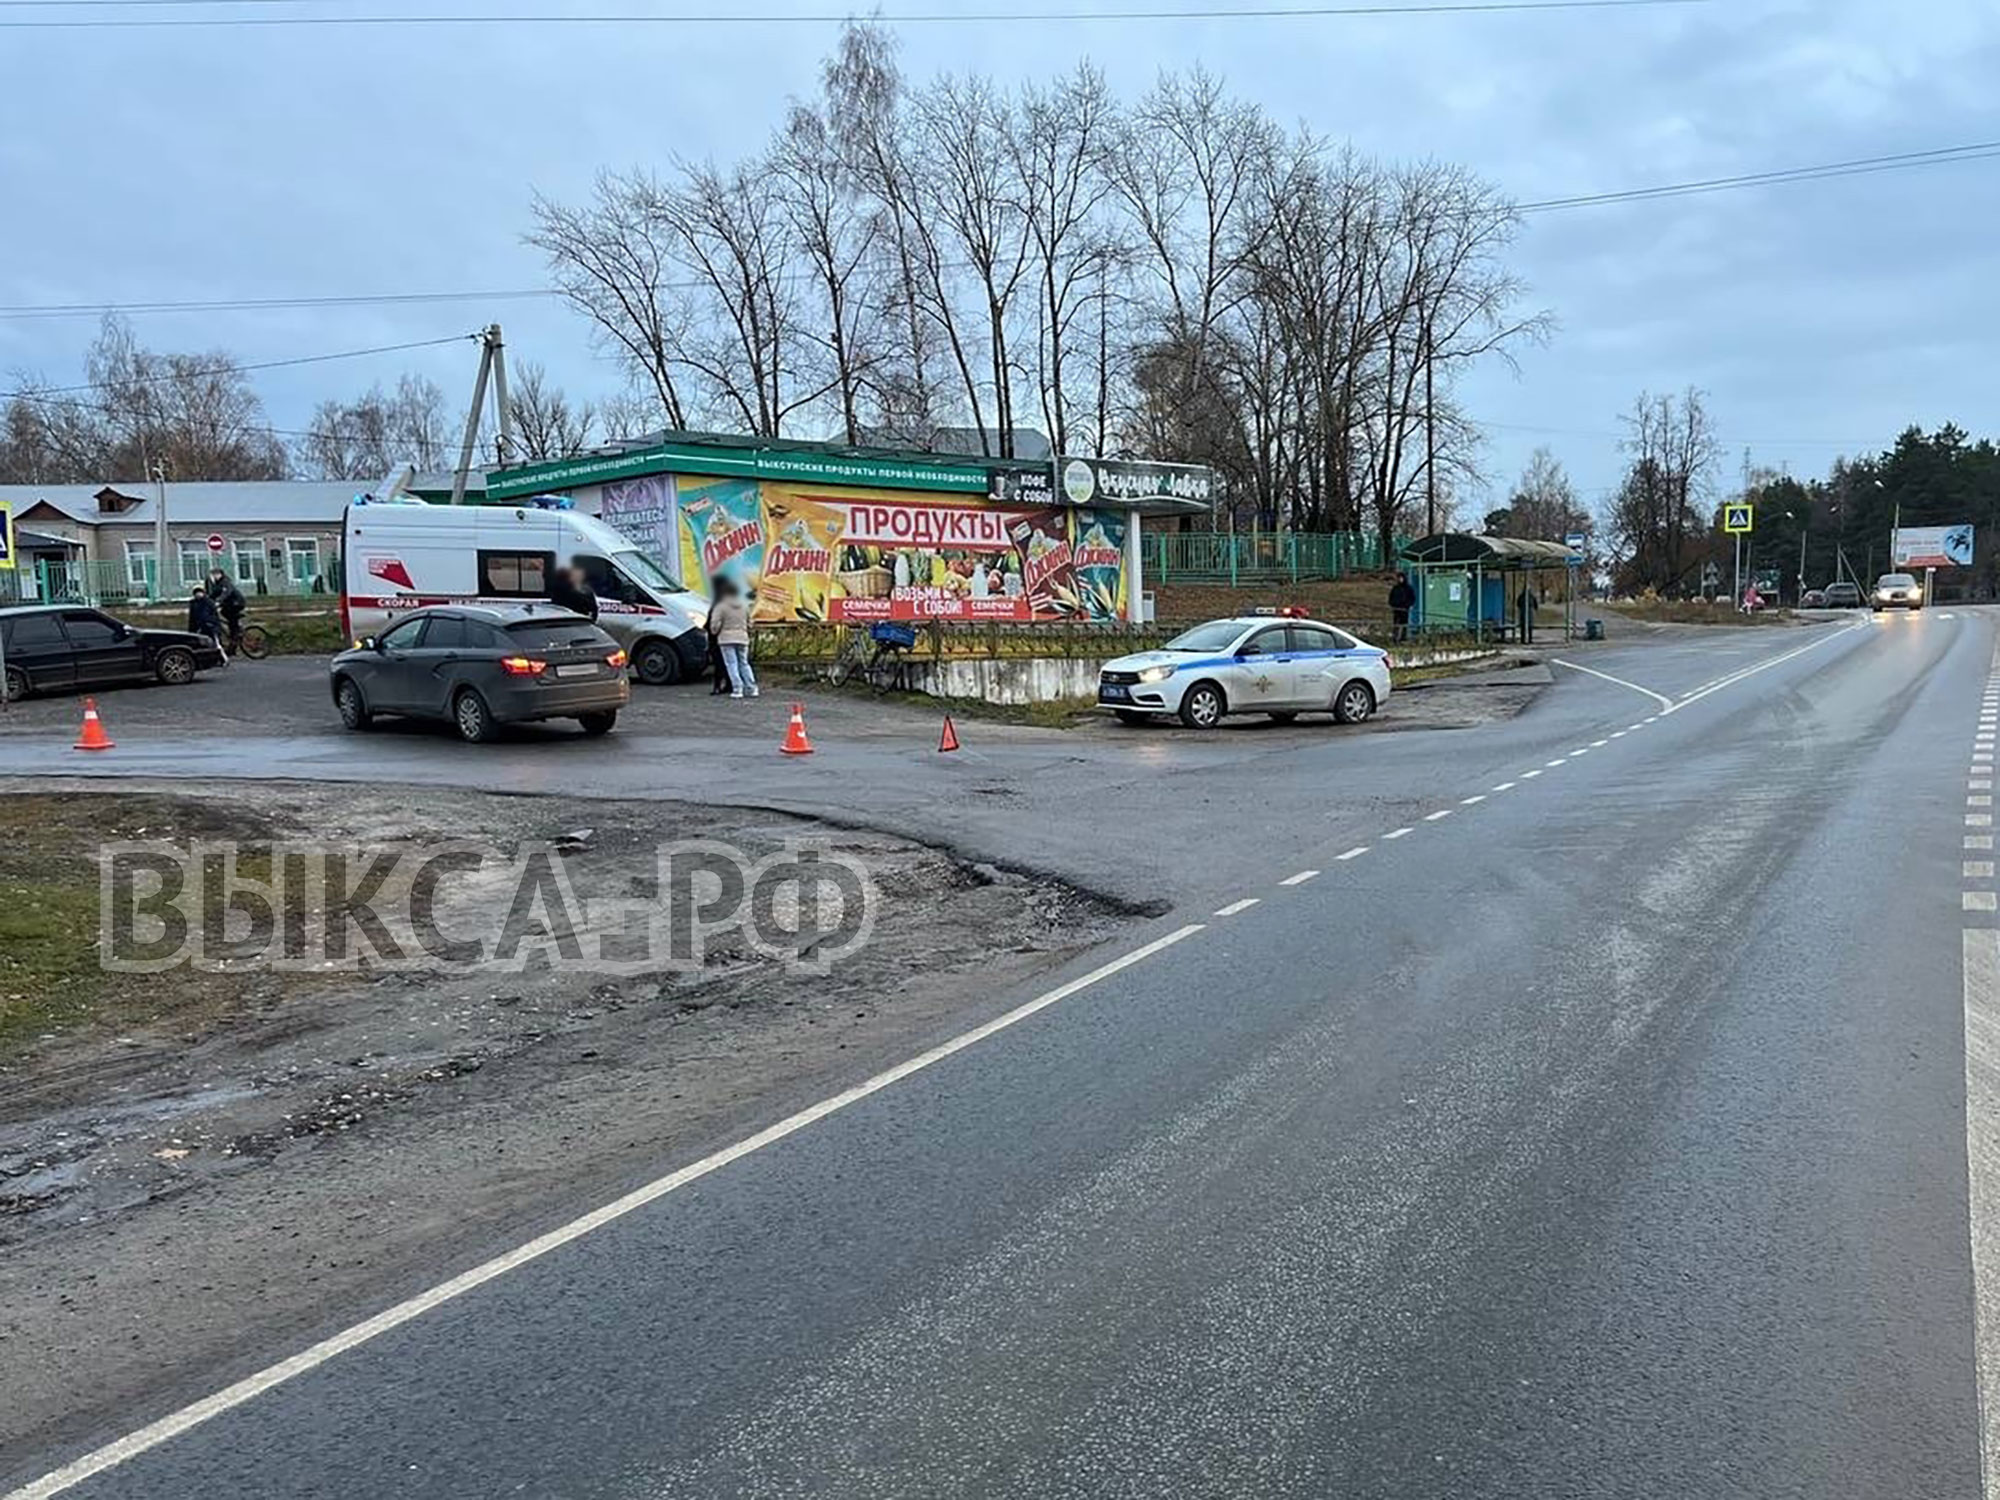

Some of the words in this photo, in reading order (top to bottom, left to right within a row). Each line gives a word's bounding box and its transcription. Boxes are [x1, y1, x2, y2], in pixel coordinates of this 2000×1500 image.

[757, 459, 824, 473] ВЫКСУНСКИЕ
[825, 464, 877, 477] ПРОДУКТЫ
[878, 468, 913, 480] ПЕРВОЙ
[915, 470, 987, 484] НЕОБХОДИМОСТИ
[1020, 474, 1047, 487] КОФЕ
[1023, 488, 1053, 503] СОБОЙ
[850, 506, 1001, 543] ПРОДУКТЫ
[895, 586, 941, 601] ВОЗЬМИ
[377, 598, 420, 608] СКОРАЯ
[598, 602, 636, 613] ОМОЩЬ
